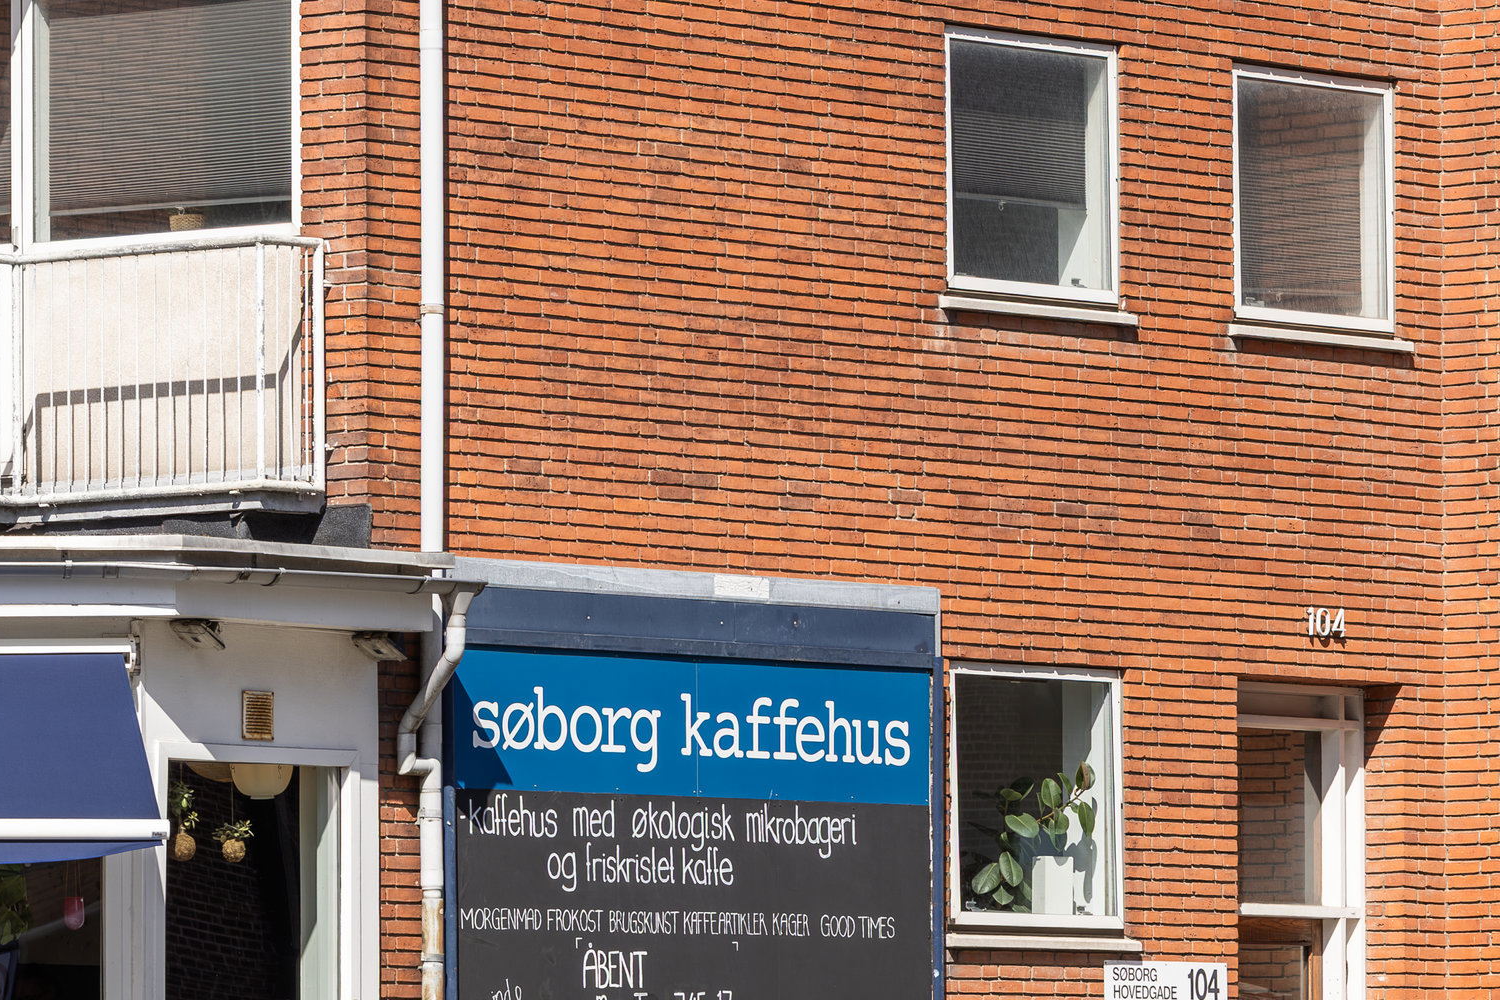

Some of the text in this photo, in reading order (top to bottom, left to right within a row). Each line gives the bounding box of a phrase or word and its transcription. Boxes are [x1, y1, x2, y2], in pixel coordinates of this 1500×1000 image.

[1304, 605, 1348, 639] 104
[472, 686, 911, 773] søborg kaffehus
[572, 799, 615, 839] med
[631, 800, 736, 853] økologisk
[745, 802, 858, 860] mikrobageri
[546, 841, 734, 893] og friskristet kaffe
[460, 907, 896, 939] MORGENMAD FROKOST BRUGSKUNST KAFFEARTIKLER KAGER GOOD TIMES
[582, 942, 648, 990] ÅBENT
[1112, 966, 1158, 982] SØBORG
[1113, 984, 1178, 1000] HOVEDGADE
[1187, 968, 1220, 1000] 104
